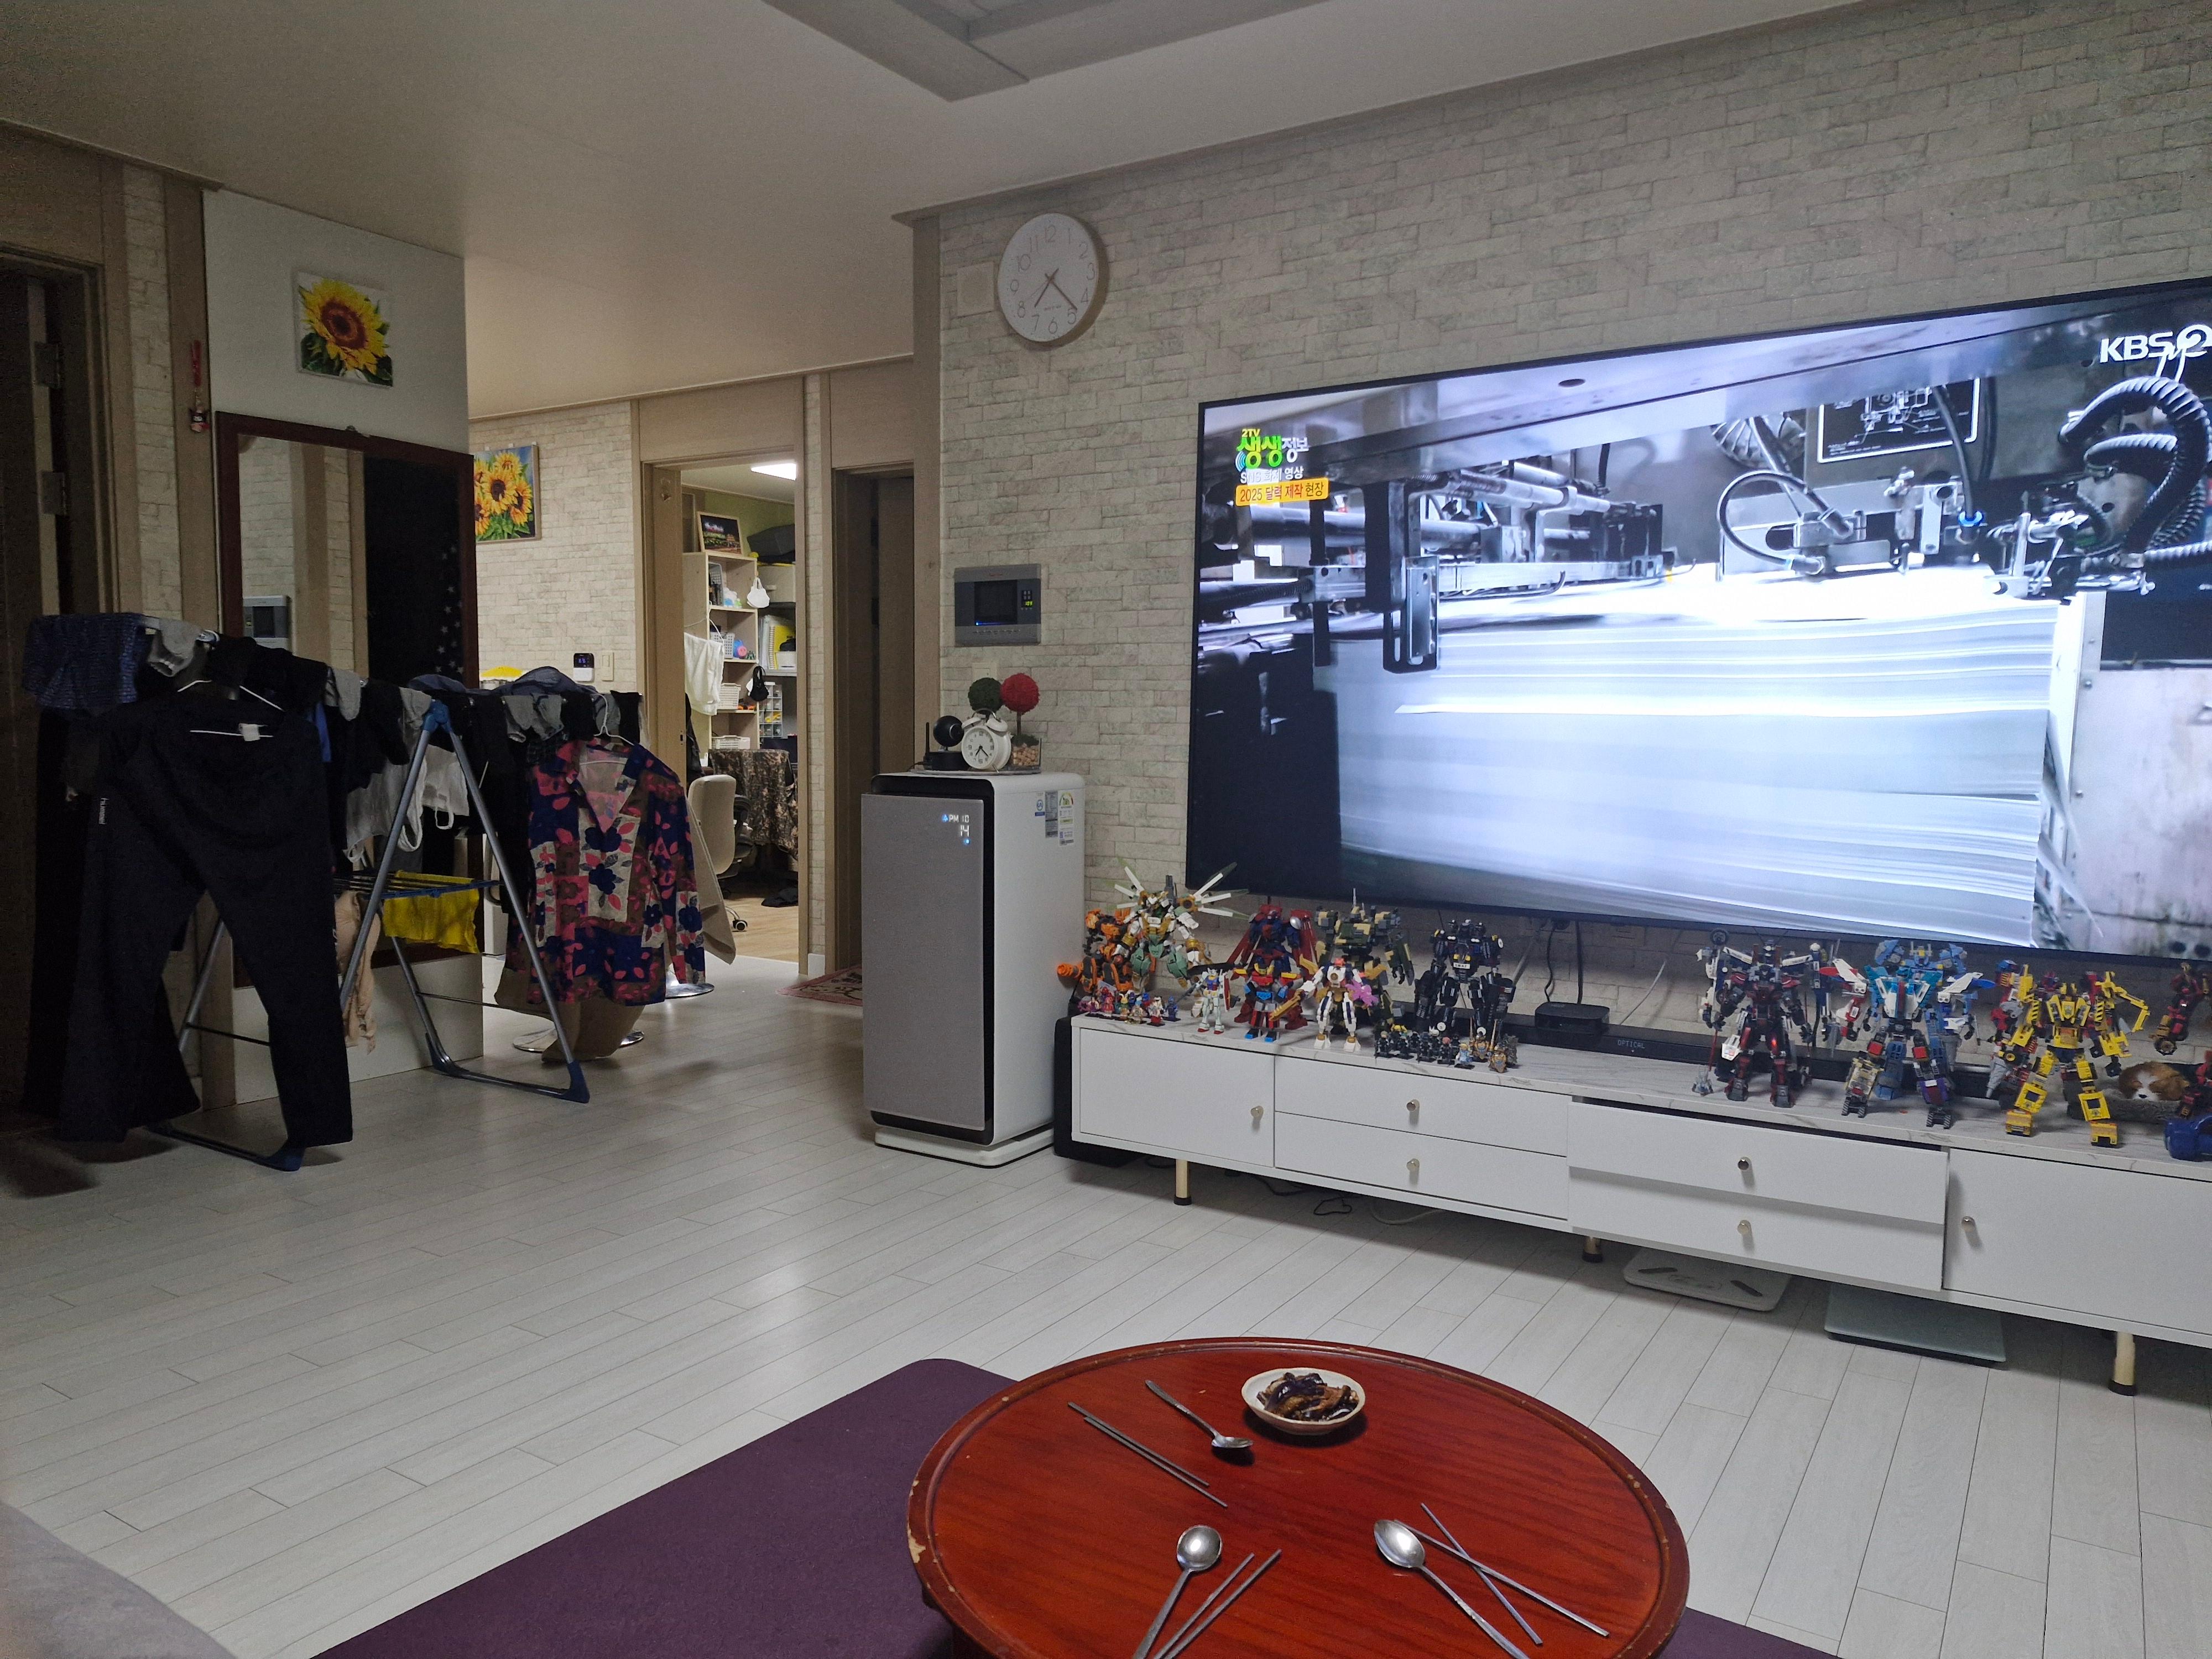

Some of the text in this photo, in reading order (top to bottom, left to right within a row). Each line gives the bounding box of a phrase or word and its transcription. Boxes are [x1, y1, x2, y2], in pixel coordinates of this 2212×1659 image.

[1045, 225, 1056, 243] 12
[1079, 241, 1088, 259] 2
[1016, 254, 1031, 273] 10
[1086, 263, 1095, 280] 3
[1010, 279, 1019, 296] 9
[1080, 287, 1089, 303] 4
[1017, 300, 1026, 319] 8
[1067, 307, 1077, 325] 5
[1031, 314, 1040, 331] 7
[1048, 317, 1058, 334] 6
[1241, 428, 1260, 437] 2TV
[1237, 435, 1310, 469] 생생정보
[1240, 466, 1304, 484] SNS 화제 영상
[1240, 482, 1324, 502] 2025 달력 제작 현장
[949, 814, 959, 823] PM
[960, 825, 969, 837] 14
[1617, 1039, 1646, 1049] OPTICAL
